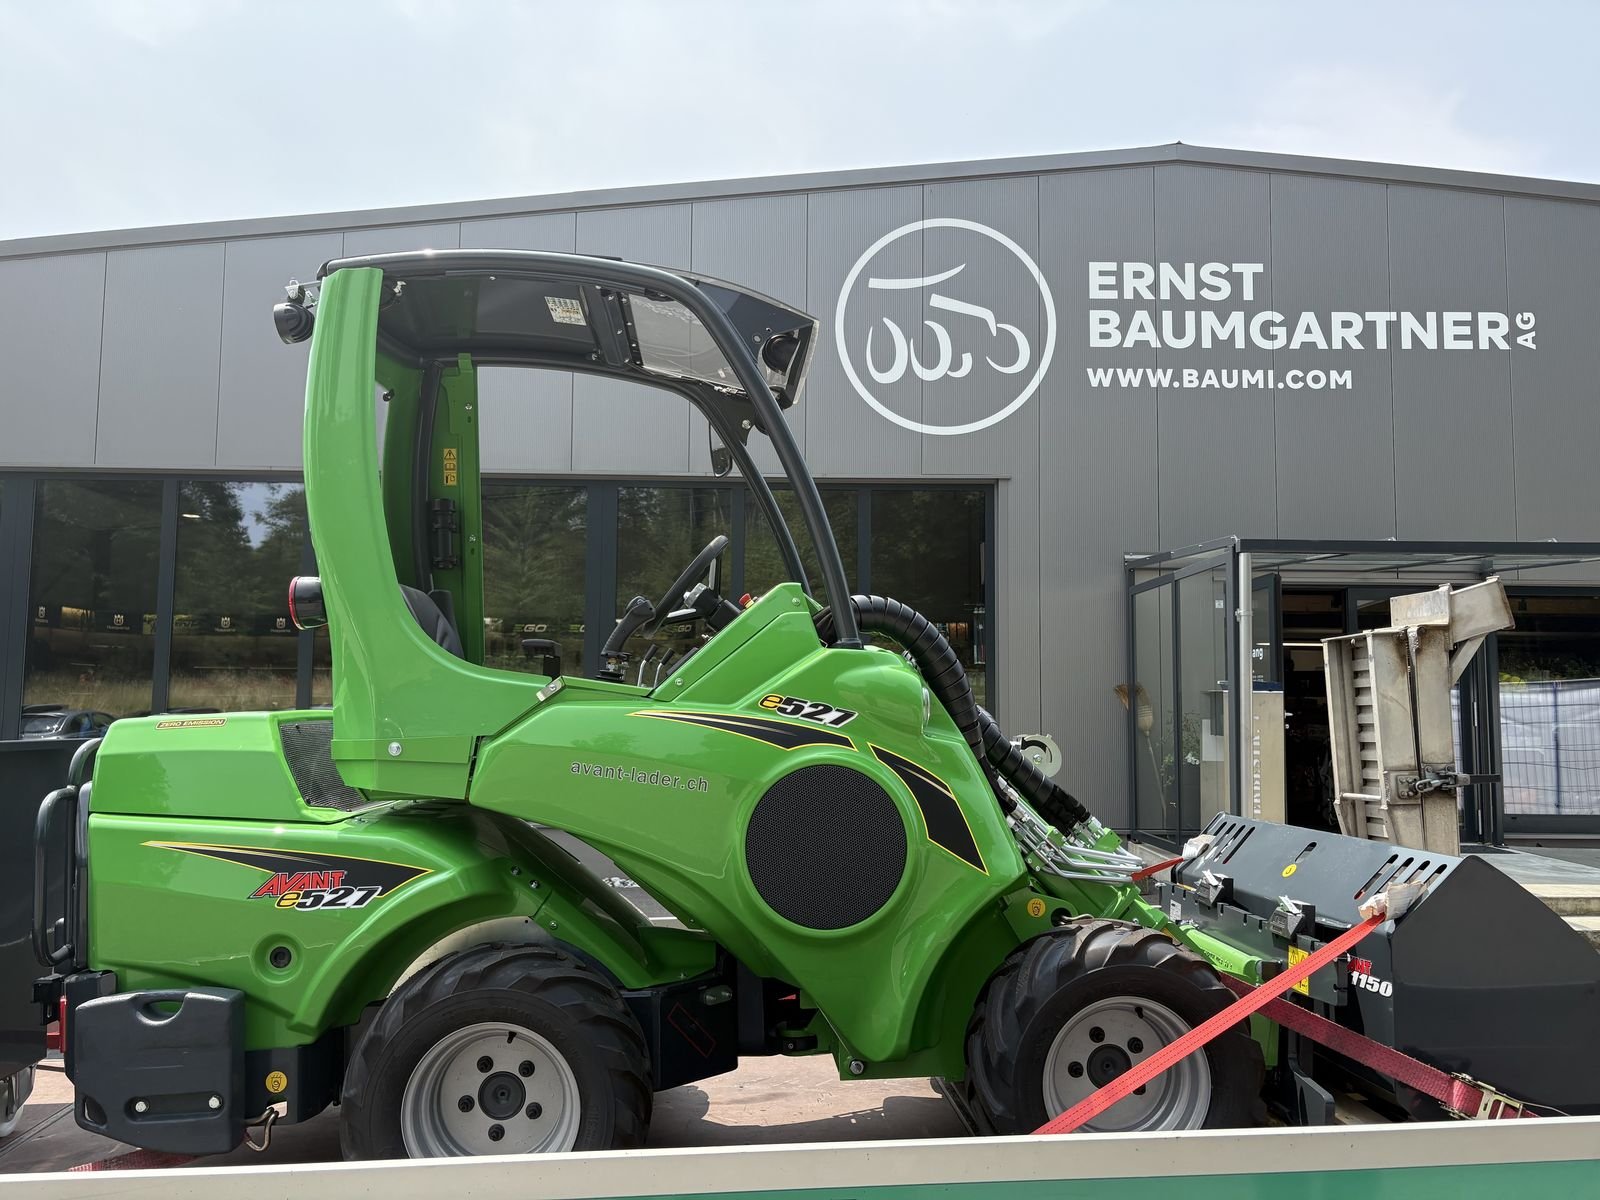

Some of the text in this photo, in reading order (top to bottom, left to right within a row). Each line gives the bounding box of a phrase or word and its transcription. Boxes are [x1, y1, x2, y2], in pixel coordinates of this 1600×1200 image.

[1088, 261, 1264, 301] ERNST
[1089, 309, 1536, 350] BAUMGARTNER AG
[1086, 367, 1353, 390] WWW.BAUMI.COM
[182, 719, 224, 727] EMISSION
[758, 694, 859, 728] e527
[570, 761, 709, 792] avant-lader.ch
[248, 870, 346, 899] AVANT
[275, 886, 382, 911] e527
[1351, 970, 1393, 997] 1150
